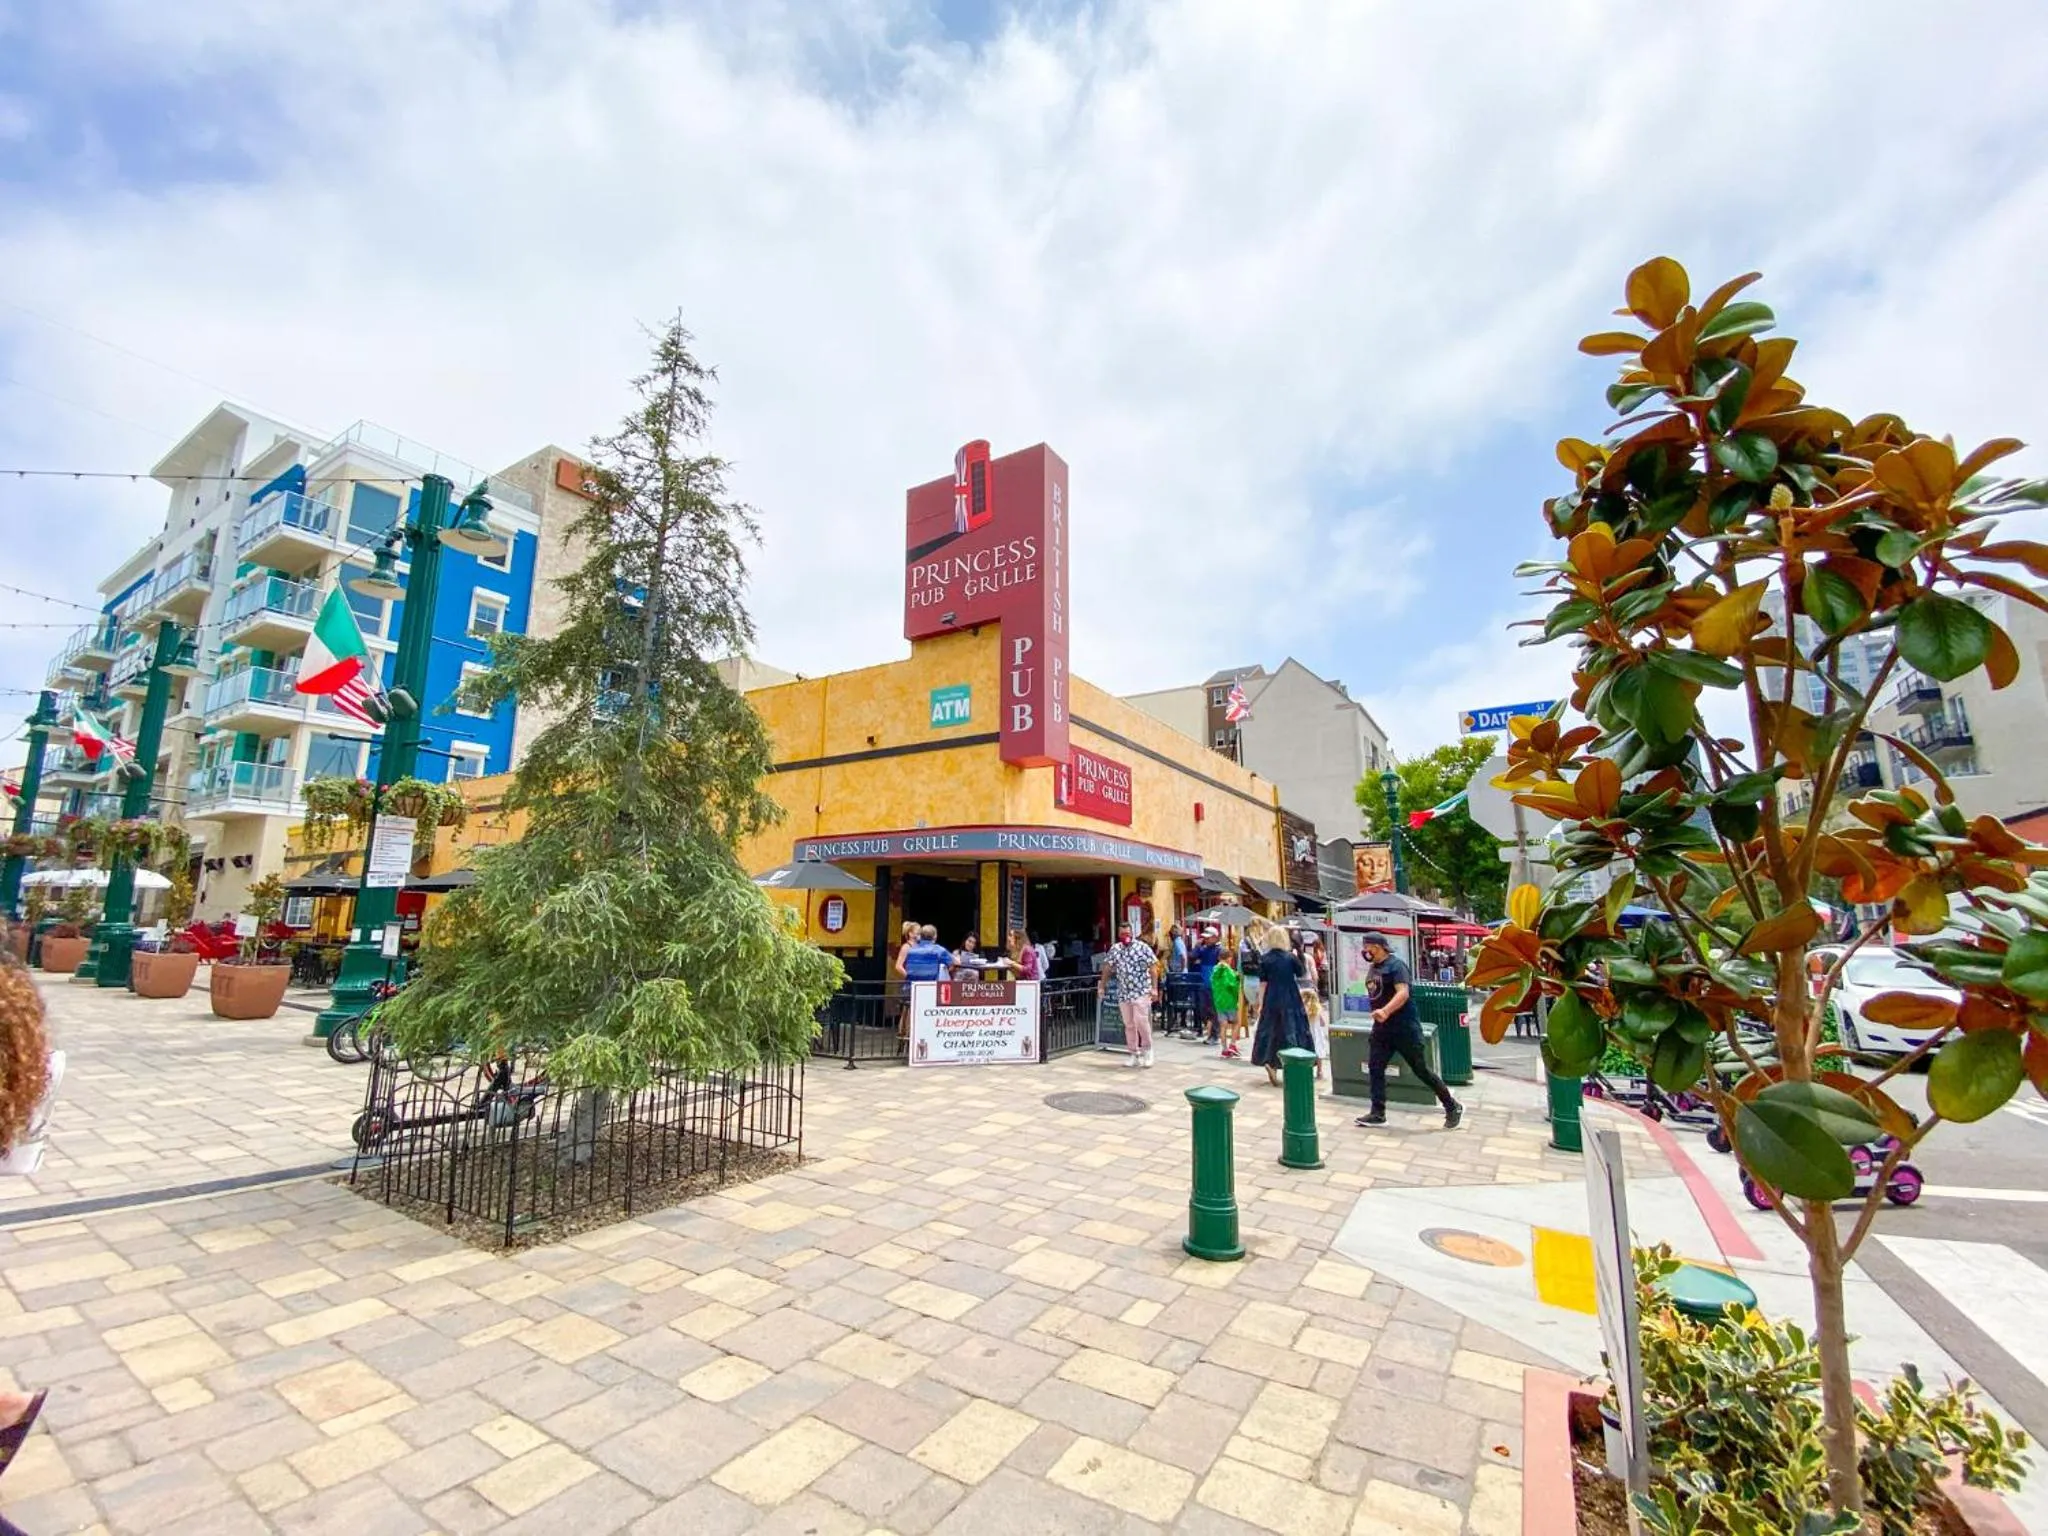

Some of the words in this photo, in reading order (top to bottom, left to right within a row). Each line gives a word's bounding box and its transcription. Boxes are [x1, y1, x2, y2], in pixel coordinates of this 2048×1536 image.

[911, 536, 1037, 589] PRINCESS
[1052, 482, 1062, 636] BRITISH
[911, 586, 945, 609] PUB
[964, 562, 1037, 601] GRILLE
[1010, 636, 1035, 733] PUB
[1053, 658, 1063, 723] PUB
[931, 698, 970, 722] ATM
[1078, 754, 1129, 789] PRINCESS
[1077, 776, 1095, 794] PUB
[1102, 785, 1130, 805] GRILLE
[804, 839, 860, 860] PRINCESS
[862, 838, 890, 854] PUB
[903, 834, 960, 853] GRILLE
[997, 832, 1074, 851] PRINCESS
[1076, 836, 1096, 852] PUB
[1102, 840, 1132, 859] GRILLE
[961, 983, 1005, 991] PRINCESS
[924, 1007, 1028, 1017] CONGRATULATIONS
[935, 1017, 994, 1029] Liverpool
[999, 1016, 1017, 1026] FC
[936, 1028, 974, 1038] Premier
[978, 1028, 1015, 1038] League
[943, 1039, 1008, 1049] CHAMPIONS
